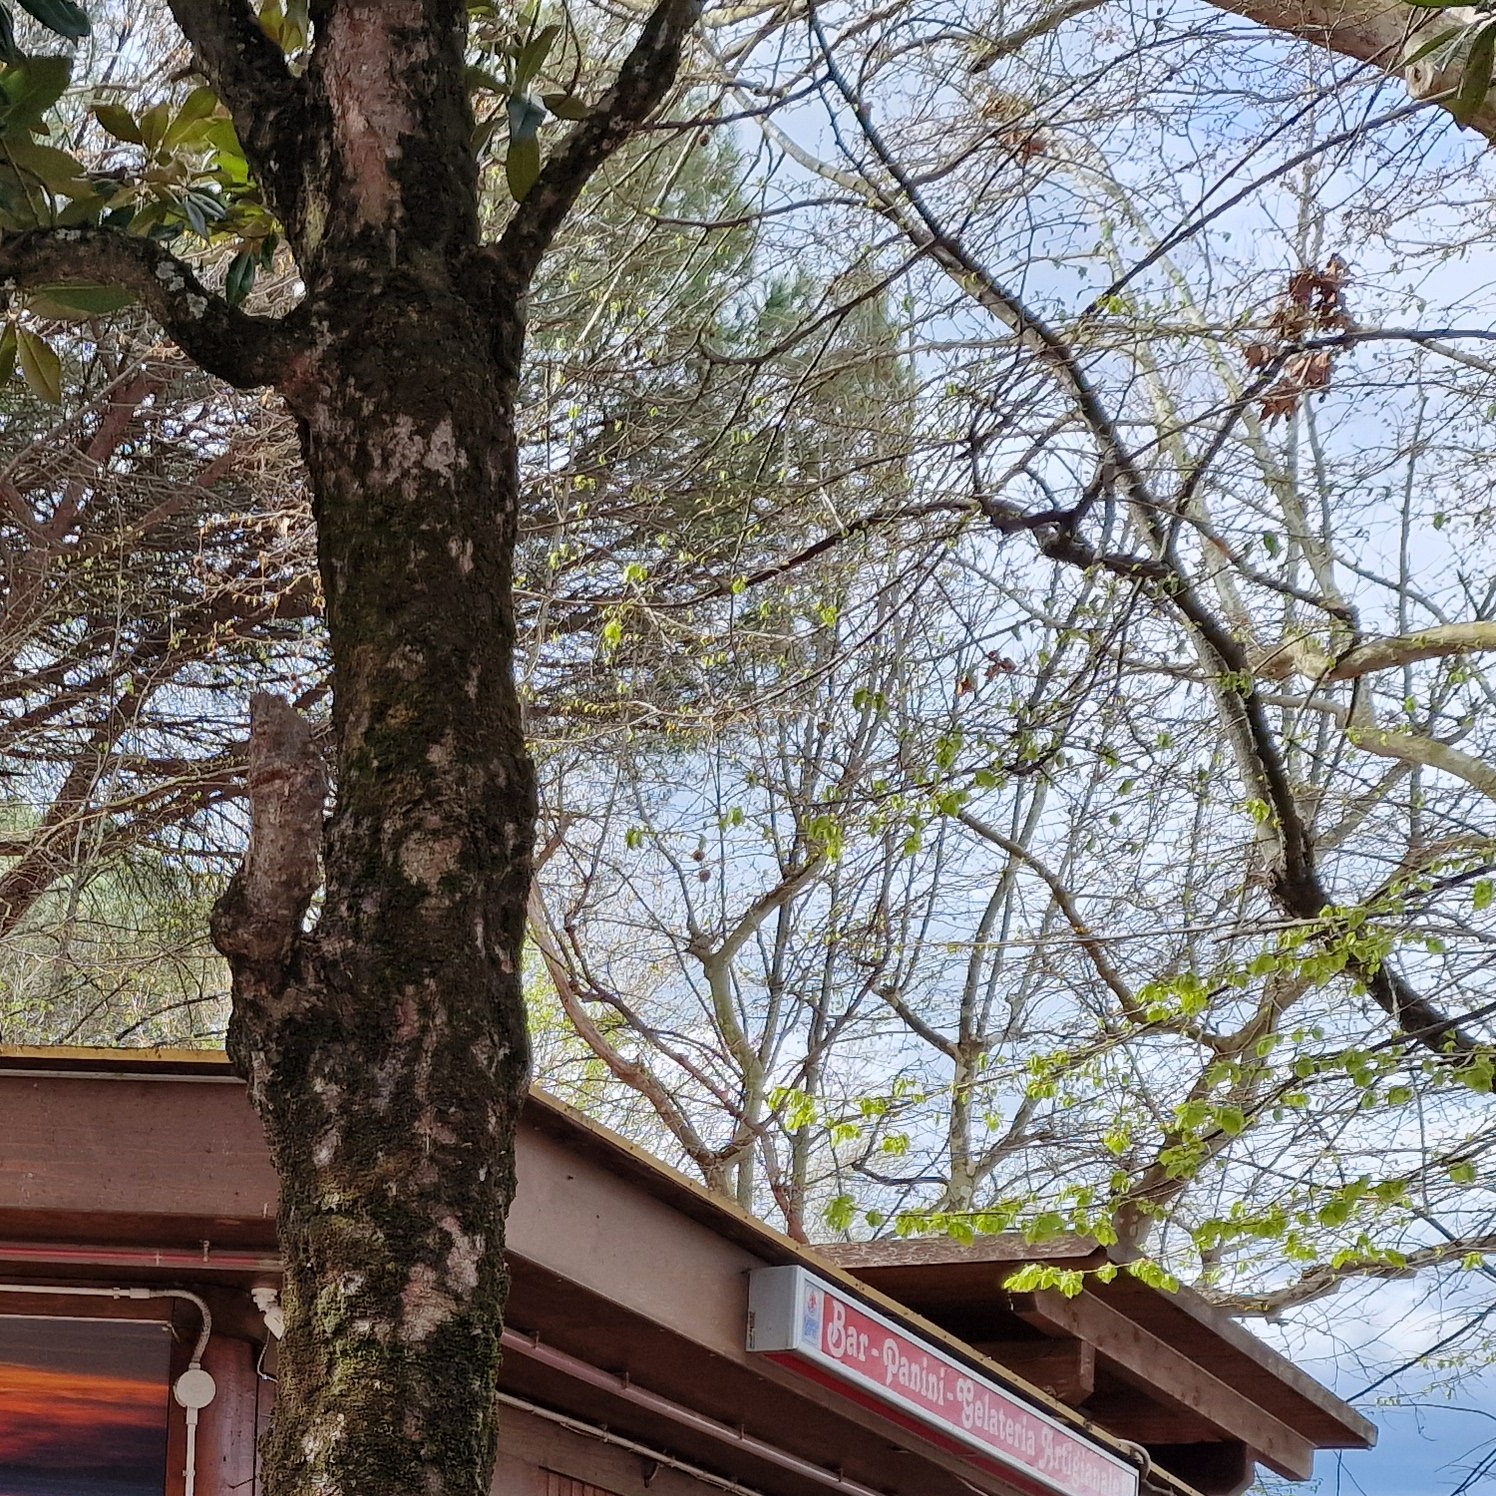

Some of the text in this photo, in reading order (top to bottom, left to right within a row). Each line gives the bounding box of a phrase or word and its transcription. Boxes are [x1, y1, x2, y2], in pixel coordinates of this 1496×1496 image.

[827, 1299, 869, 1362] Bar
[882, 1337, 945, 1406] Panini
[956, 1377, 1036, 1457] Gelateria
